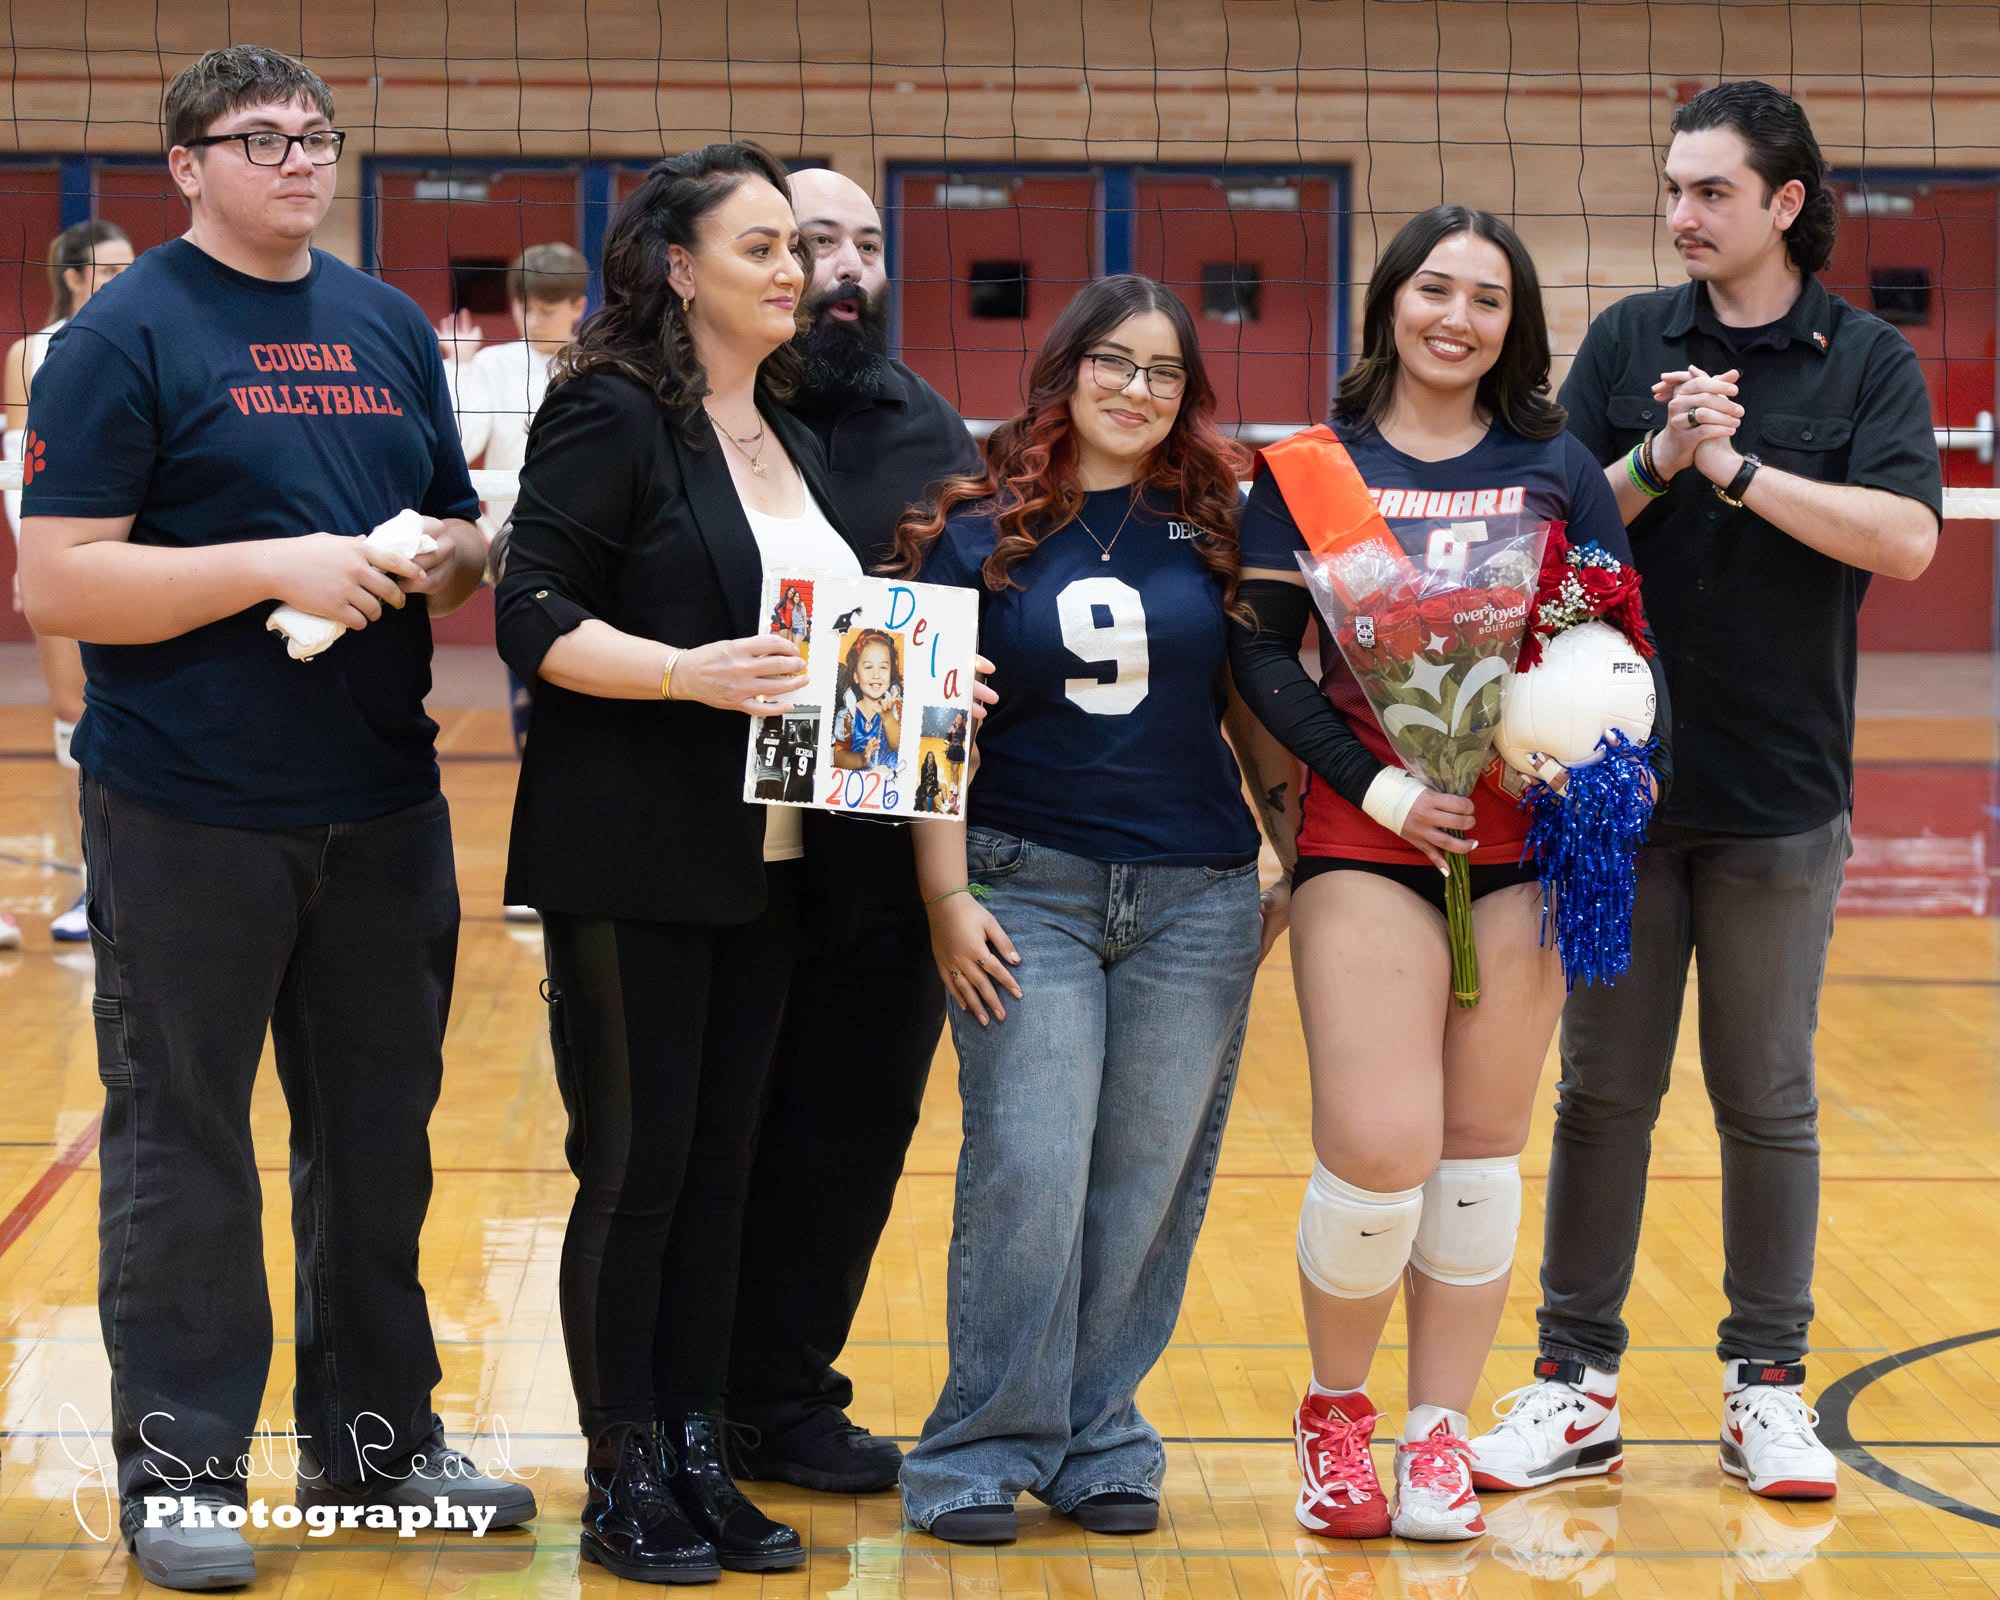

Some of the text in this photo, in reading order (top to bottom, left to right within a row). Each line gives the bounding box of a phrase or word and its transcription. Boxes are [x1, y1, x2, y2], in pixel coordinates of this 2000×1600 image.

[250, 343, 357, 372] COUGAR
[229, 385, 403, 417] VOLLEYBALL
[1453, 600, 1527, 625] overjoyed
[1478, 618, 1526, 635] BOUTIQUE
[885, 586, 961, 700] Dela
[1056, 577, 1149, 715] 9
[765, 746, 776, 767] 9
[797, 756, 808, 776] 9
[825, 769, 899, 810] 2026
[1761, 1367, 1787, 1382] NIKE
